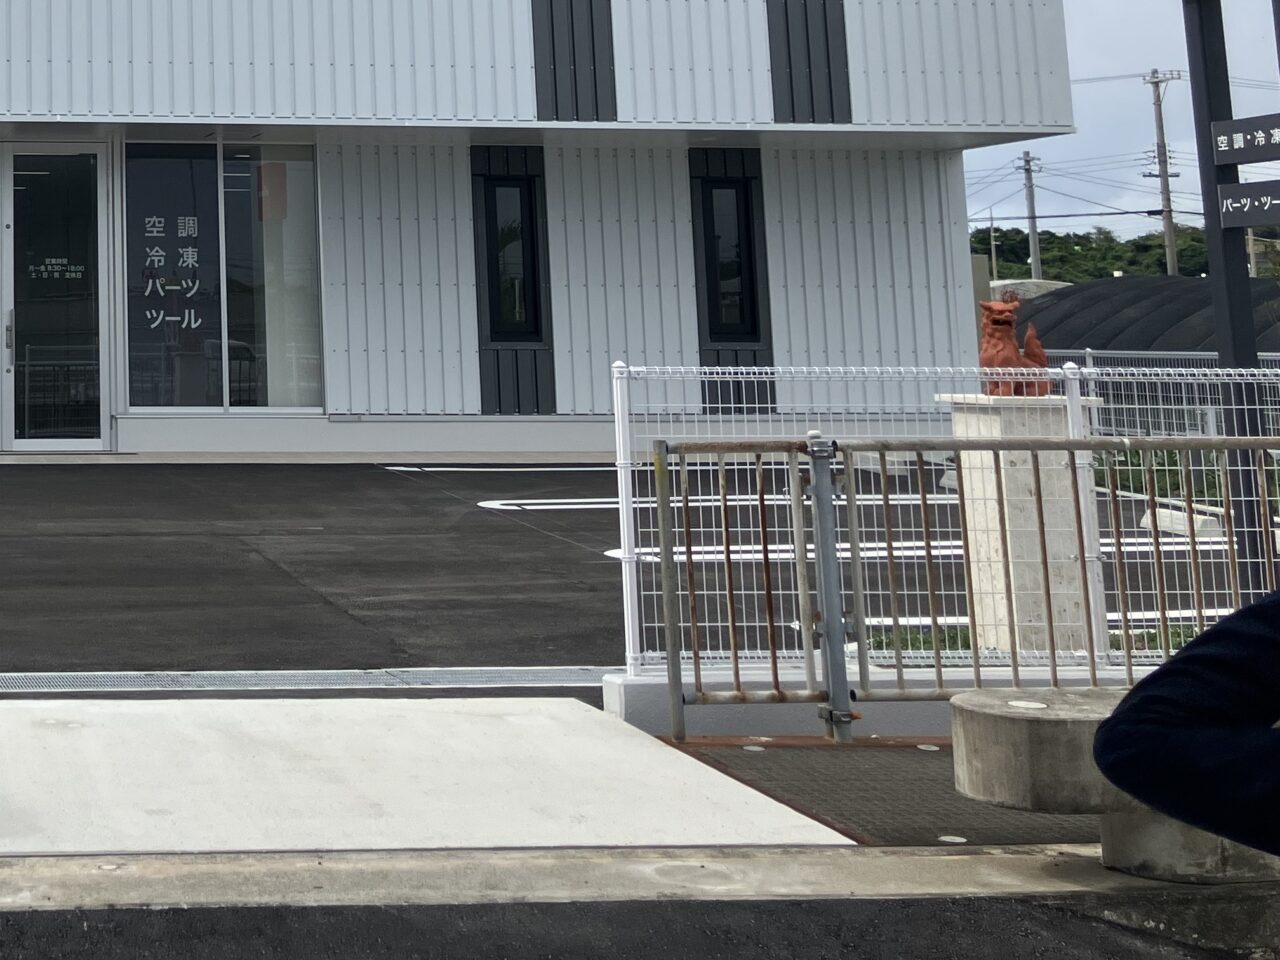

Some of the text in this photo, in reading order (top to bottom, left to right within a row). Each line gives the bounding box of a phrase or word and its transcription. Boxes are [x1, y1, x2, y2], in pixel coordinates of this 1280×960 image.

[144, 278, 199, 297] パーツ
[145, 309, 202, 328] ツール
